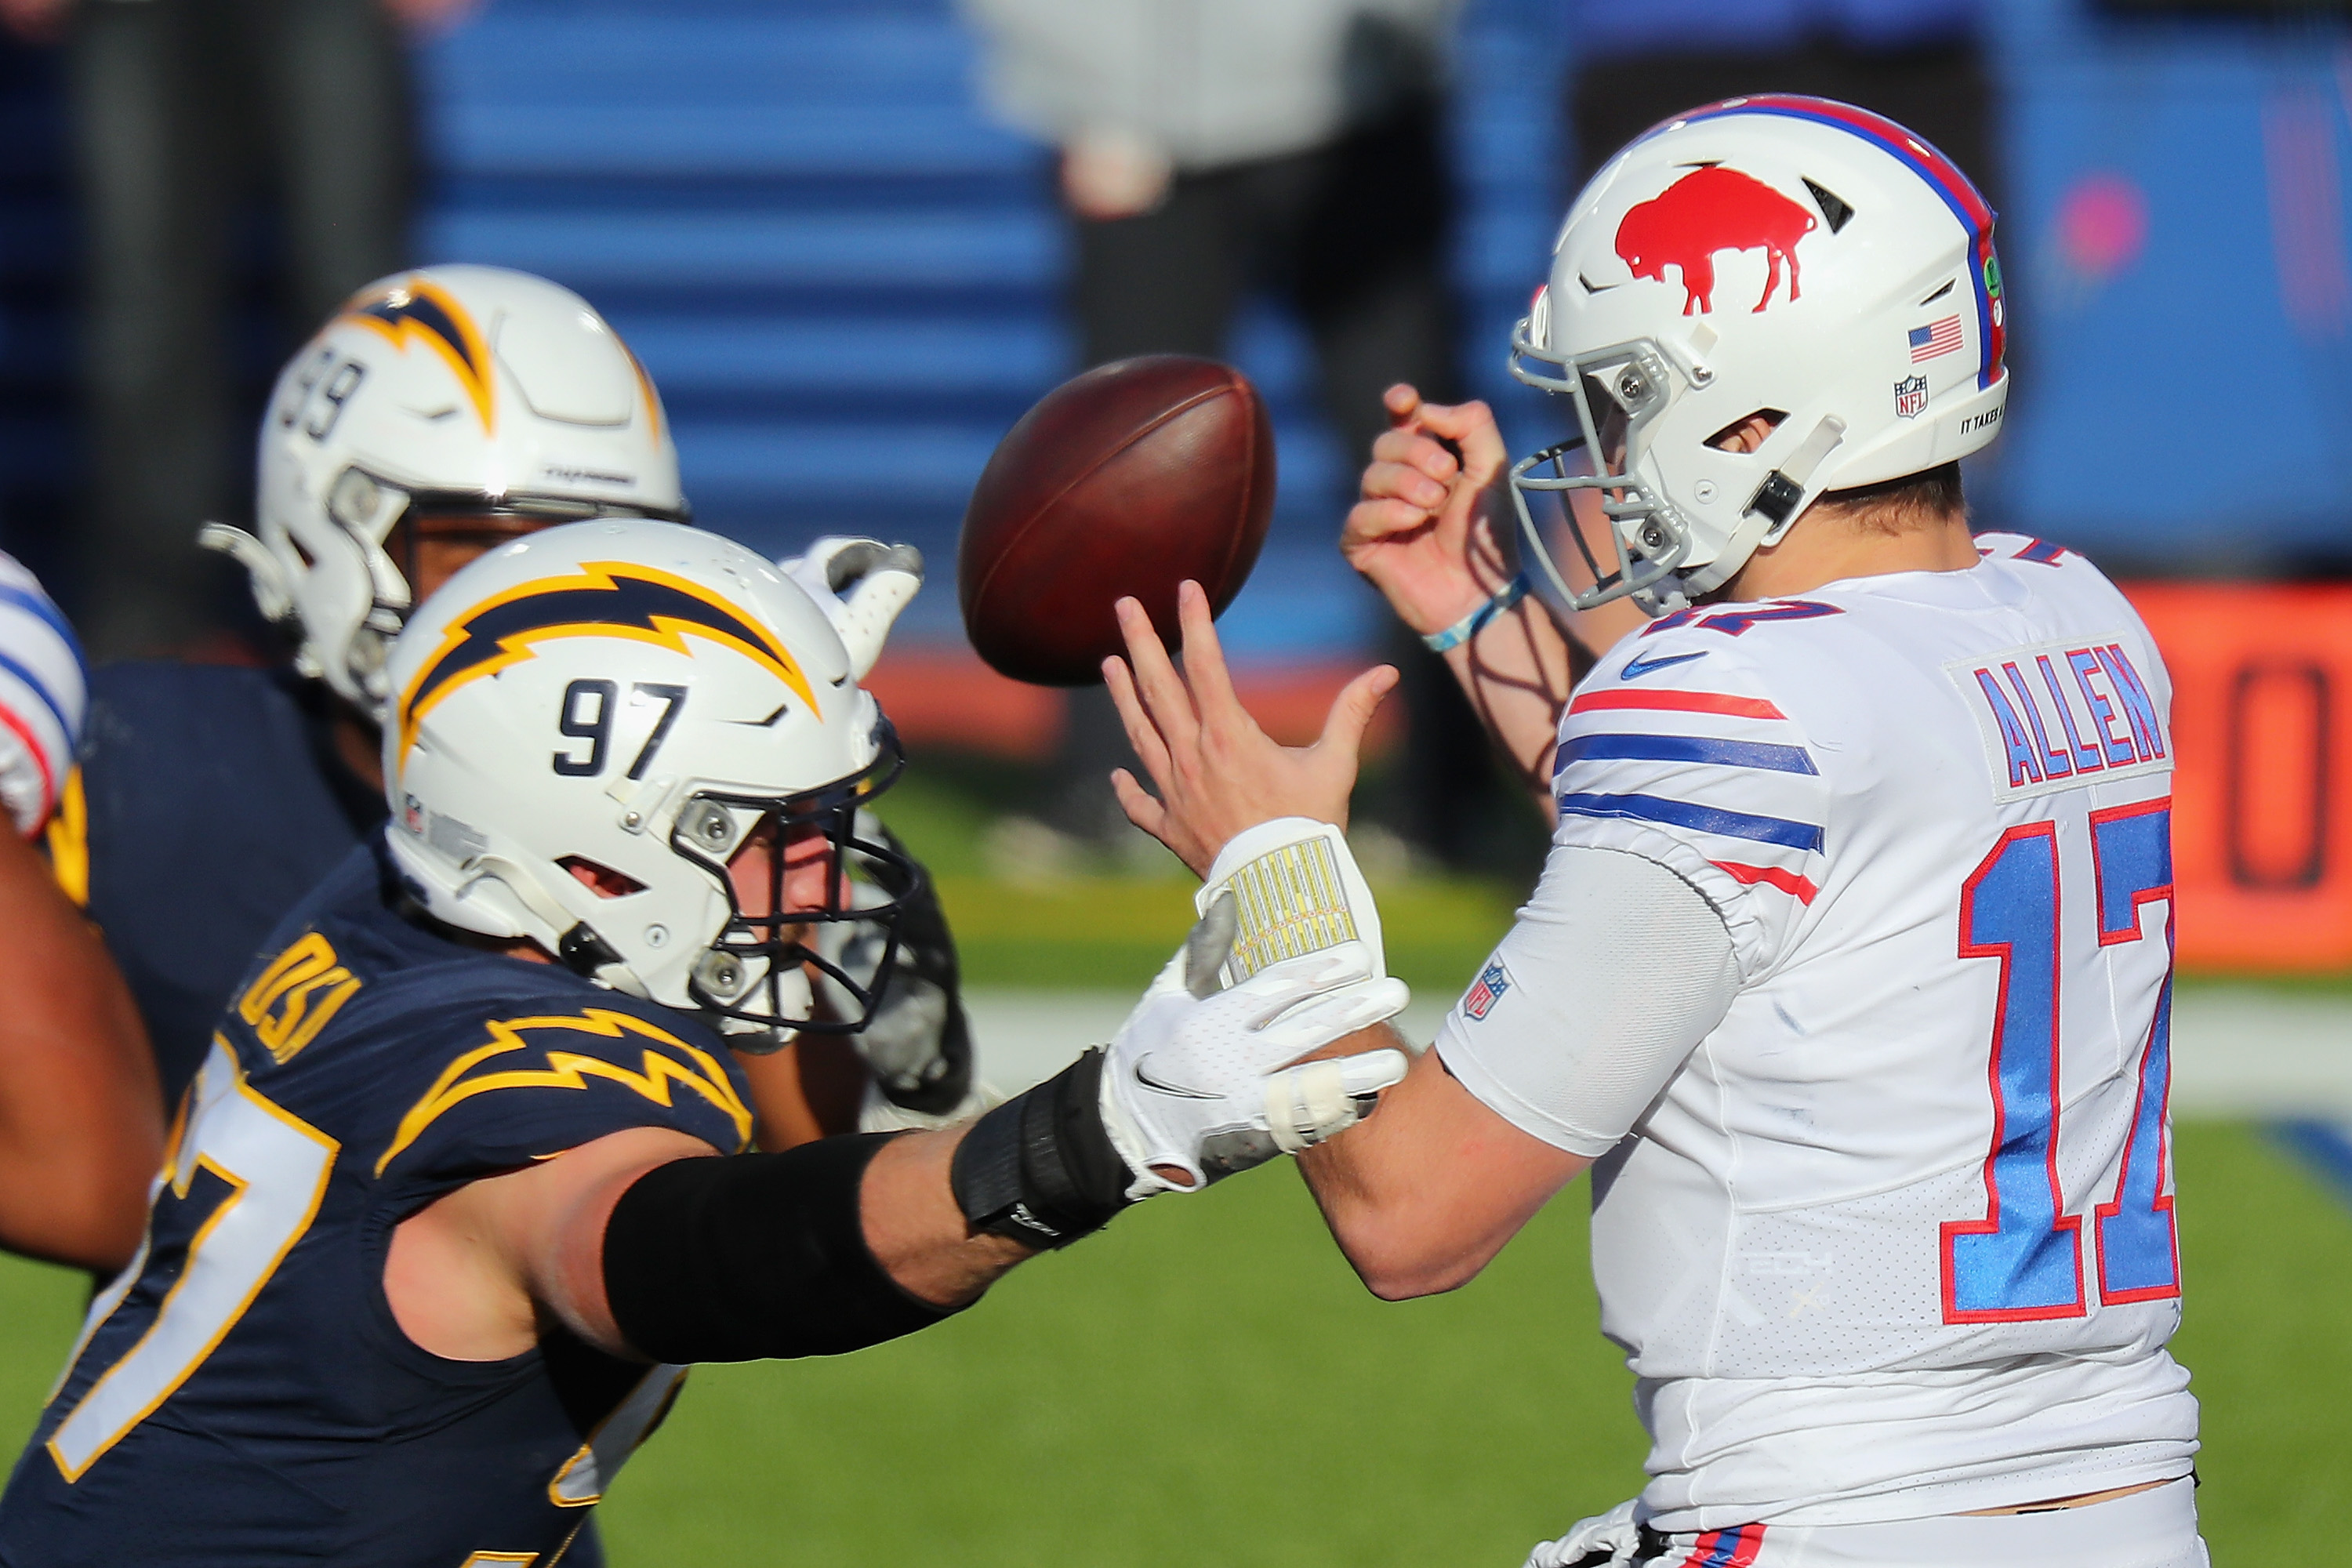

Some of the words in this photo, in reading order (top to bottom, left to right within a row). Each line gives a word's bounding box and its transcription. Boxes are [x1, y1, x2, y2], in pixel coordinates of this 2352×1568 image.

[1898, 392, 1926, 415] NFL
[1960, 419, 1973, 436] IT
[1973, 406, 2000, 431] TAKES
[552, 677, 689, 782] 97
[1974, 643, 2166, 788] ALLEN
[1467, 980, 1494, 1017] NFL
[1940, 795, 2181, 1325] 17
